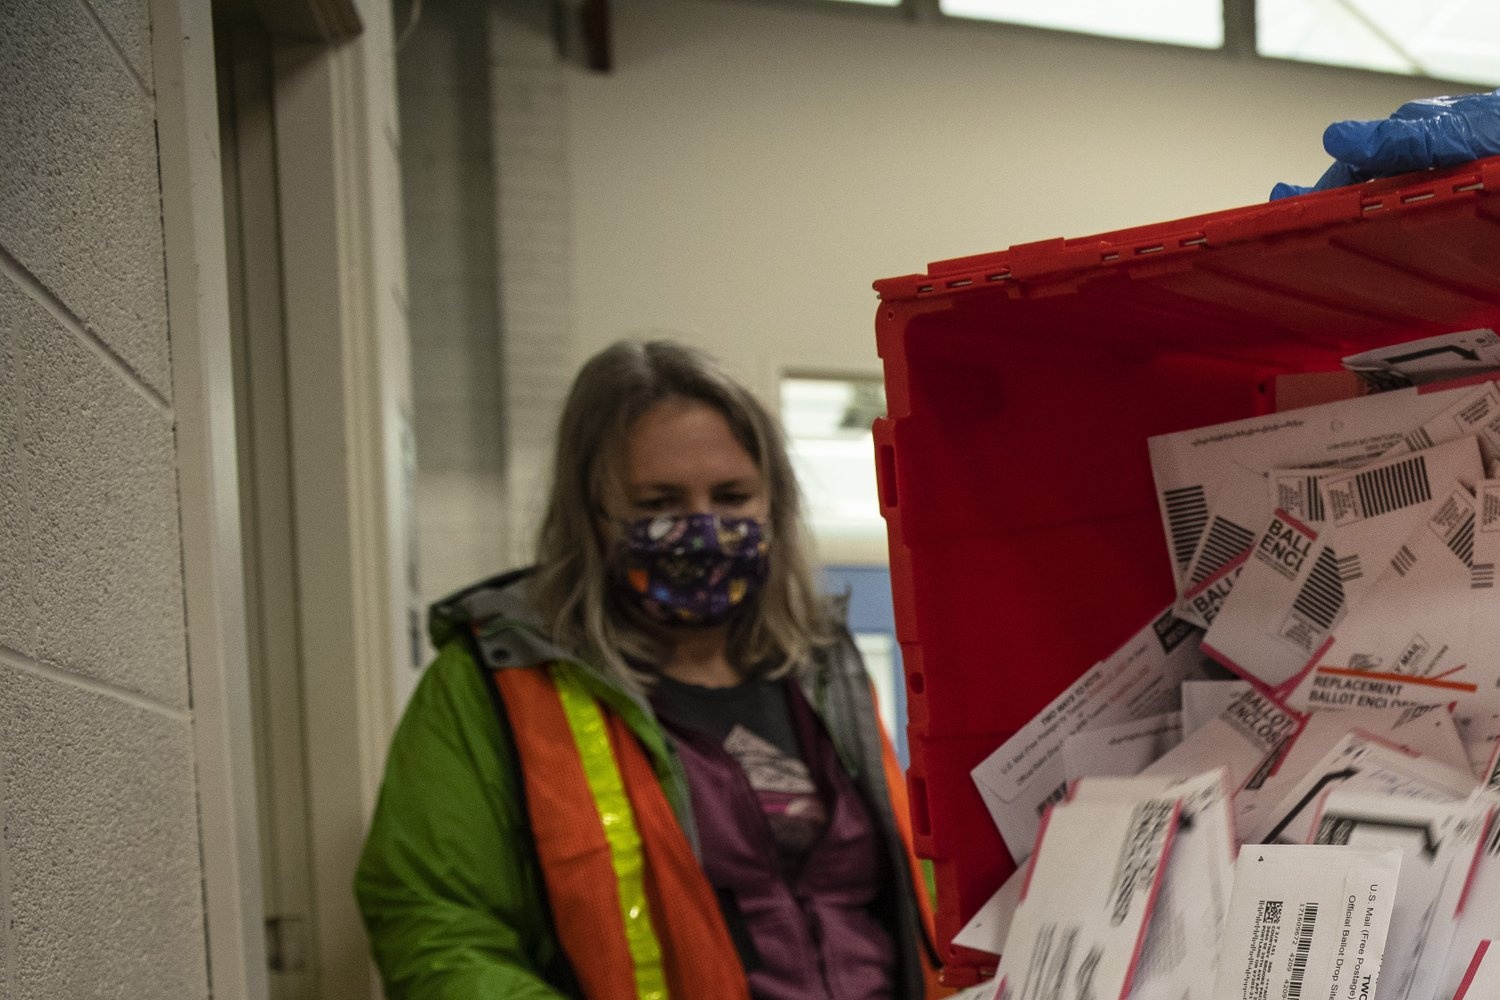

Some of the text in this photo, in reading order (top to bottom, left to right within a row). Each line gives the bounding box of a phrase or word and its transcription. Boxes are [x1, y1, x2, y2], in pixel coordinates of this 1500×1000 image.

[1309, 690, 1355, 706] BALLOT
[1314, 675, 1403, 697] REPLACEMENT
[1368, 884, 1378, 904] U.S.
[1344, 894, 1356, 927] Official
[1364, 907, 1374, 927] Mail
[1268, 925, 1276, 959] COURTNEY
[1338, 929, 1350, 956] Ballot
[1358, 929, 1369, 955] (Free
[1286, 952, 1294, 972] 4209
[1332, 958, 1344, 982] Drop
[1348, 957, 1364, 1000] Postage)
